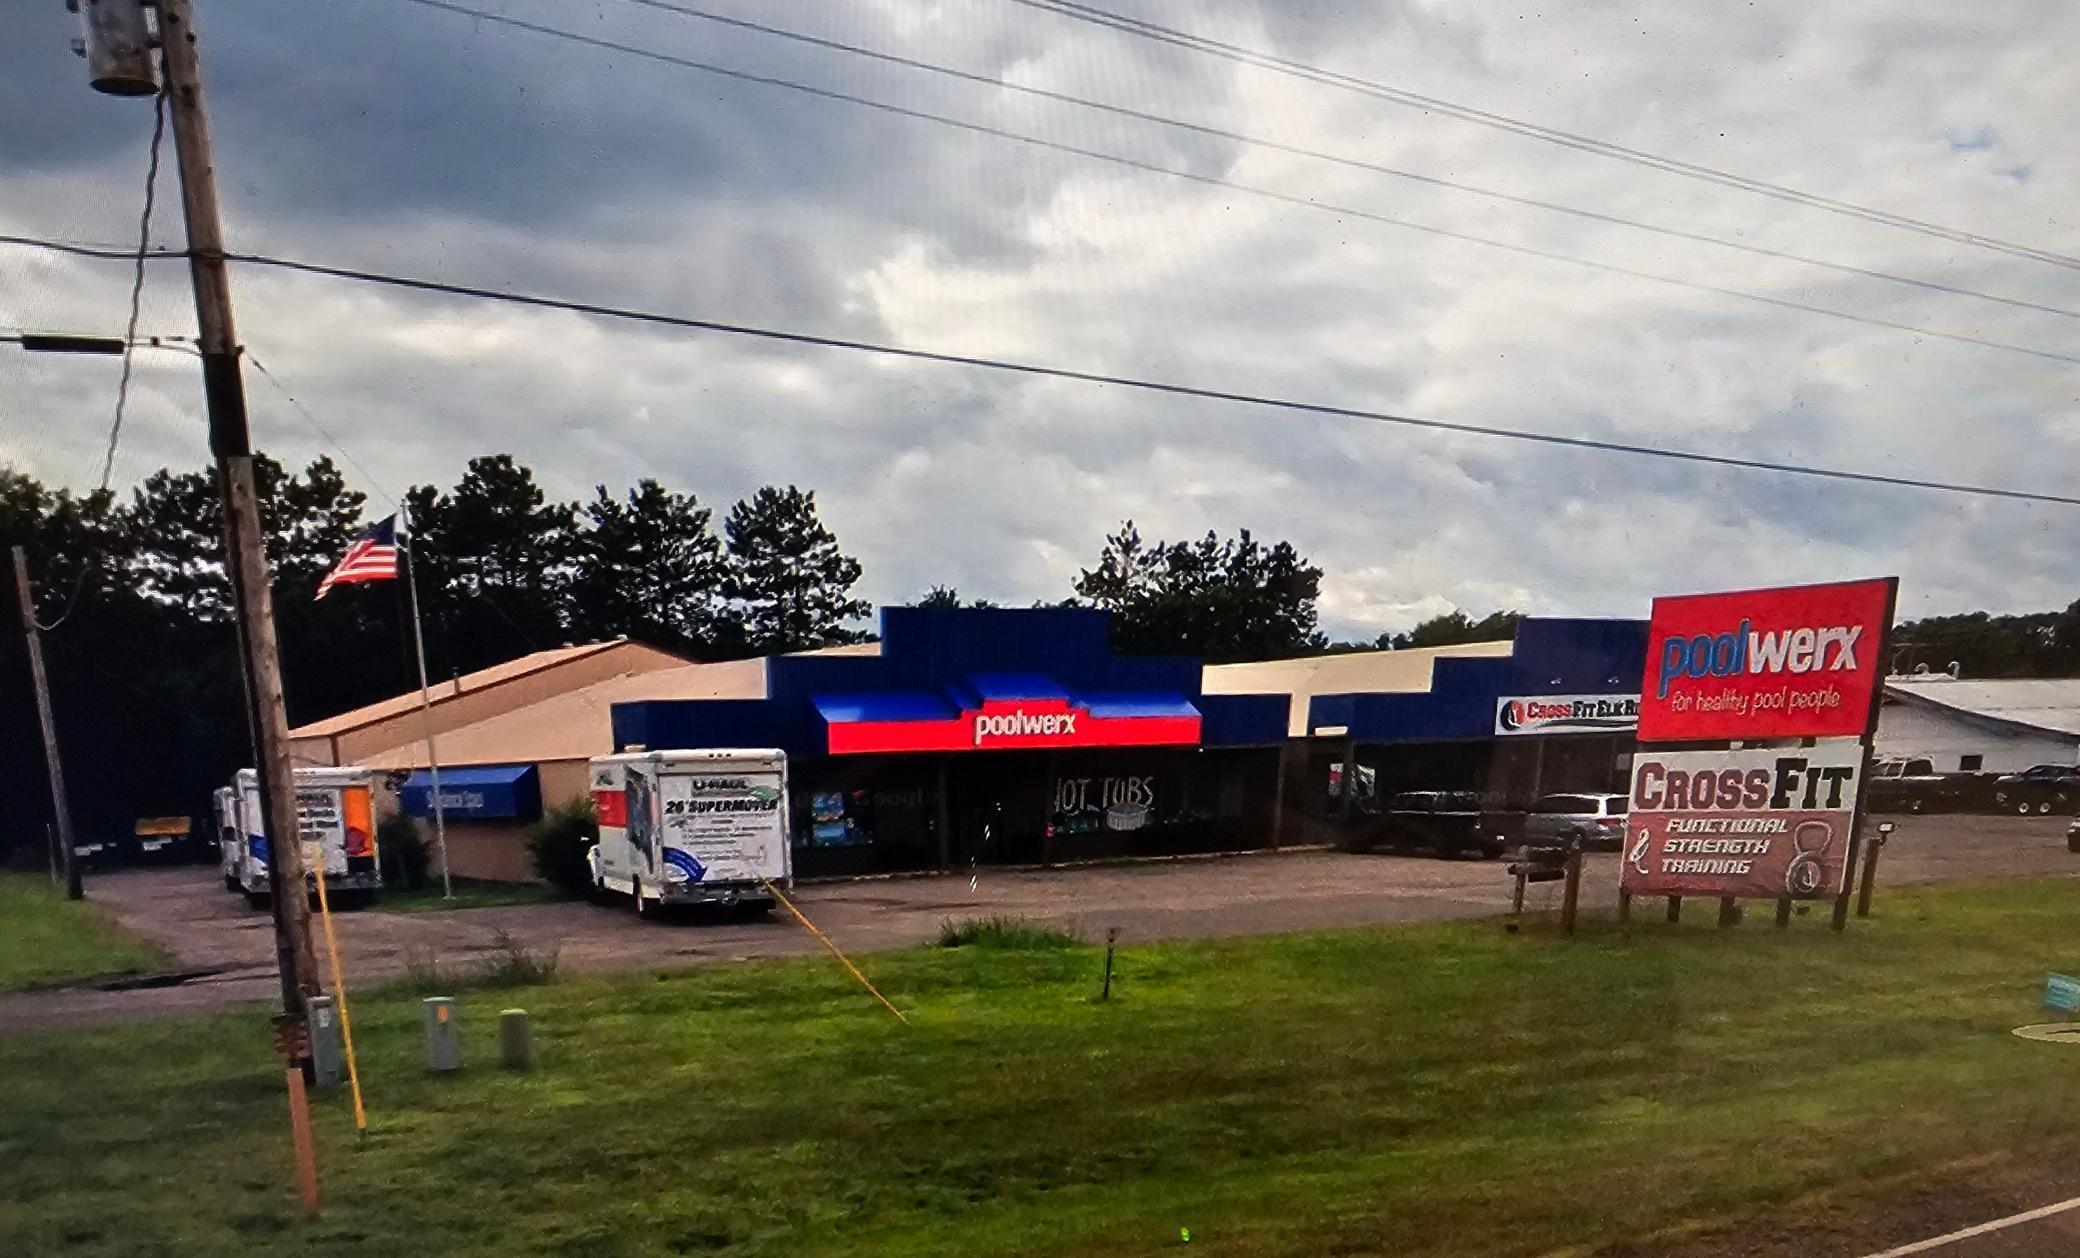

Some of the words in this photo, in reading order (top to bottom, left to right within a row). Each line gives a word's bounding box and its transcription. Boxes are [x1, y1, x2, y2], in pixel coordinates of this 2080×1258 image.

[1657, 617, 1863, 699] poolwerx
[1671, 689, 1692, 712] for
[1696, 686, 1749, 715] healthy
[1751, 685, 1787, 717] pool
[1788, 683, 1840, 715] people
[976, 709, 1076, 745] poolwerx
[1102, 776, 1154, 808] TUBS
[1665, 818, 1789, 833] FUNCTIONAL
[1664, 837, 1770, 854] STRENGTH
[1661, 857, 1754, 875] TRAINING
